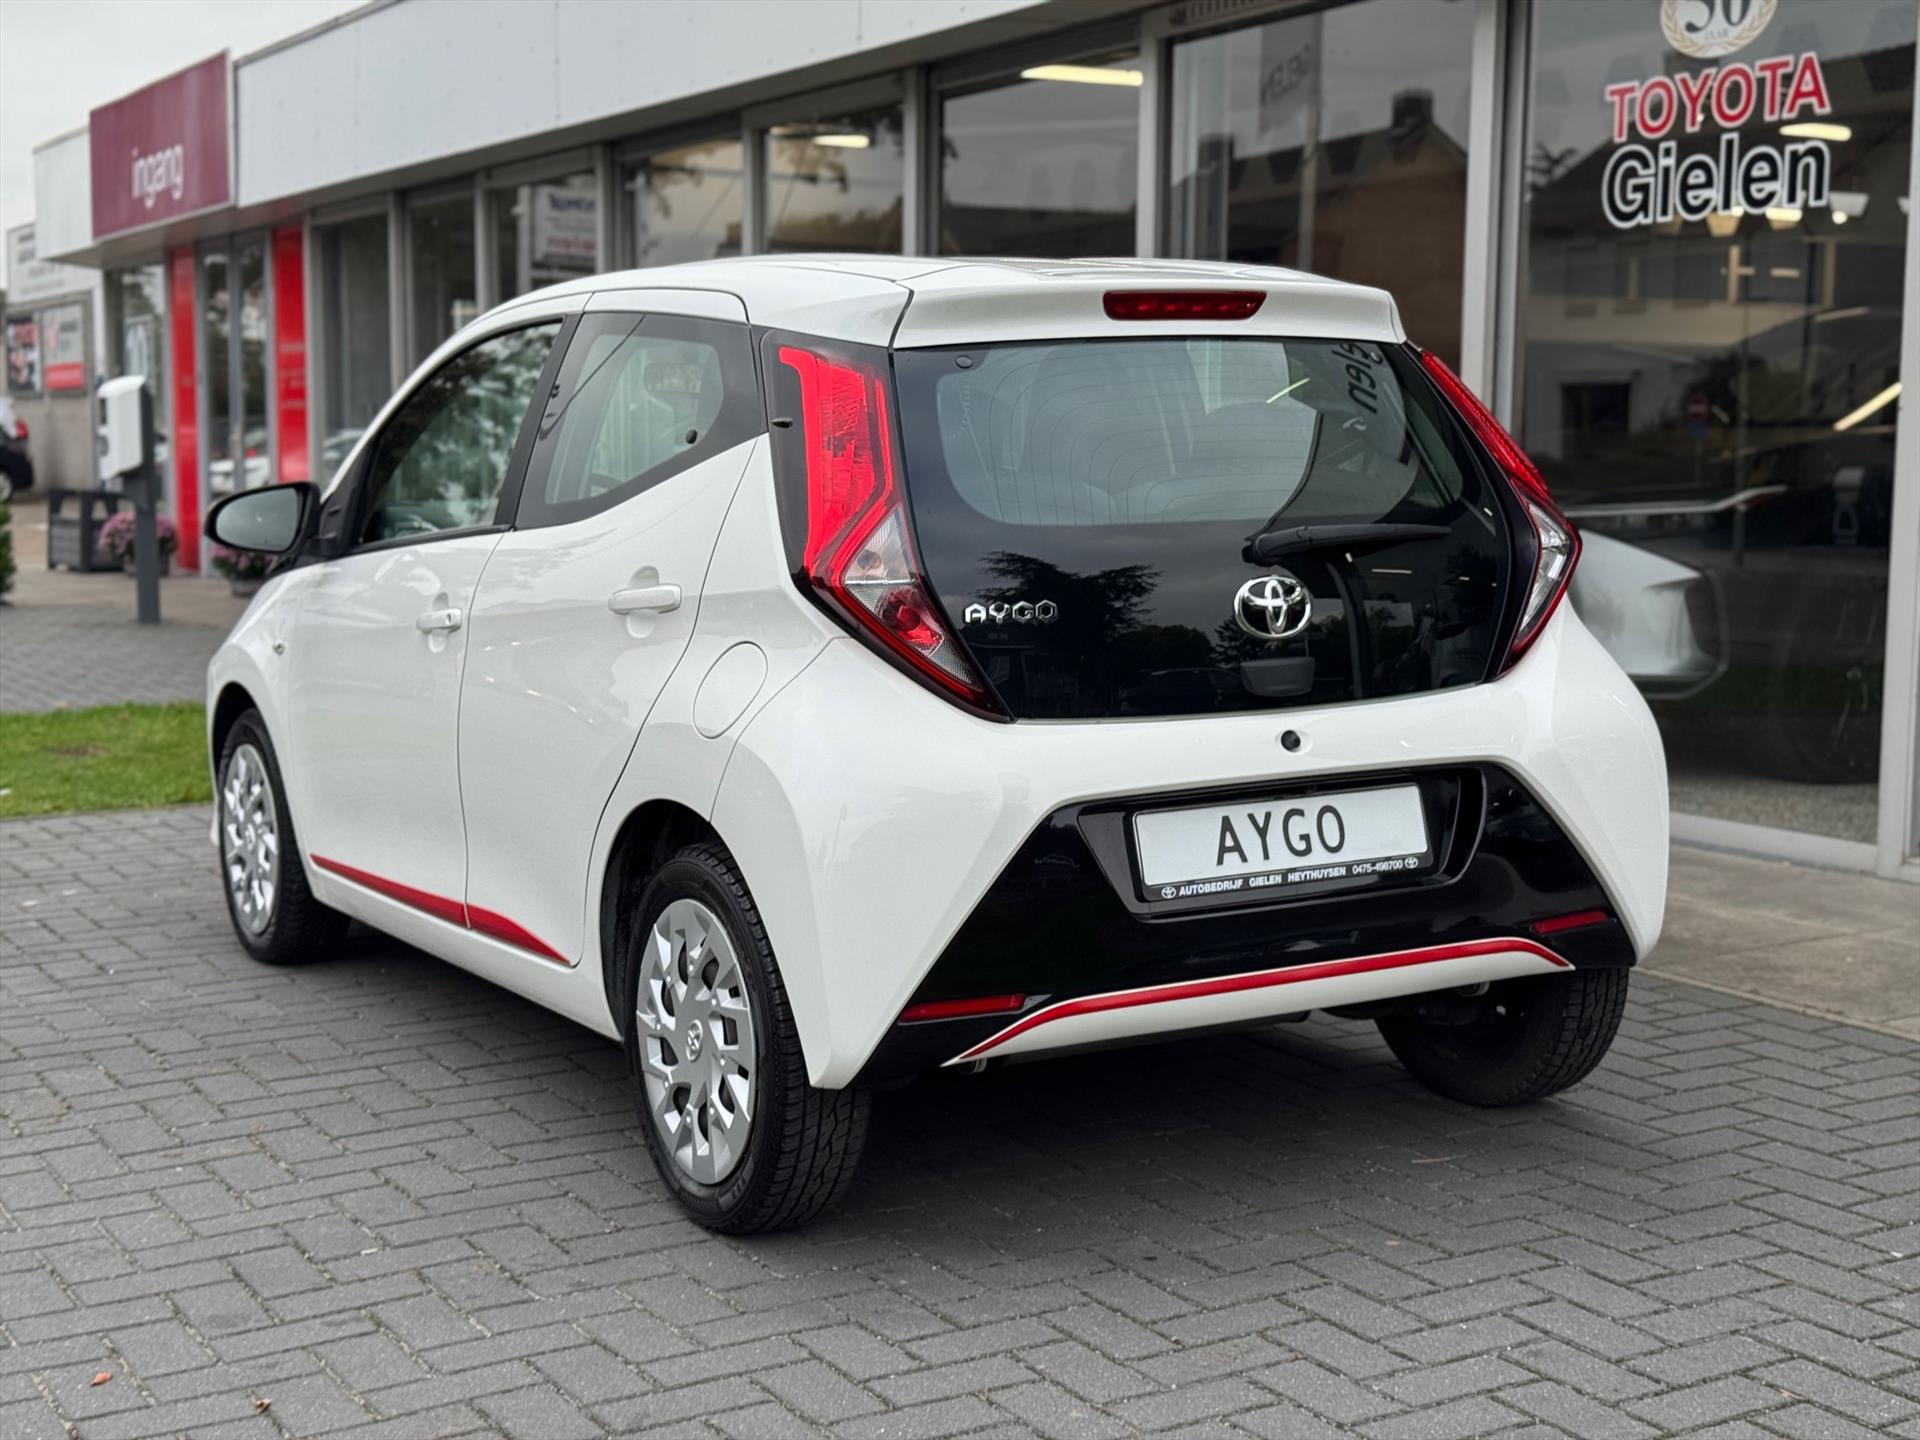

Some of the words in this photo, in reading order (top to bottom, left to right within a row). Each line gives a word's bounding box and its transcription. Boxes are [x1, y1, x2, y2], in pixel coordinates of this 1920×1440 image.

[1606, 53, 1830, 141] TOYOTA
[132, 145, 183, 209] ingang
[1603, 133, 1829, 228] Gielen
[964, 599, 1058, 624] AYGO
[1216, 805, 1345, 866] AYGO
[1179, 880, 1243, 896] AUTOBEDRIJF
[1249, 874, 1282, 887] GIELEN
[1288, 867, 1346, 882] HEYTHUYSEN
[1352, 860, 1403, 874] 0475-498700
